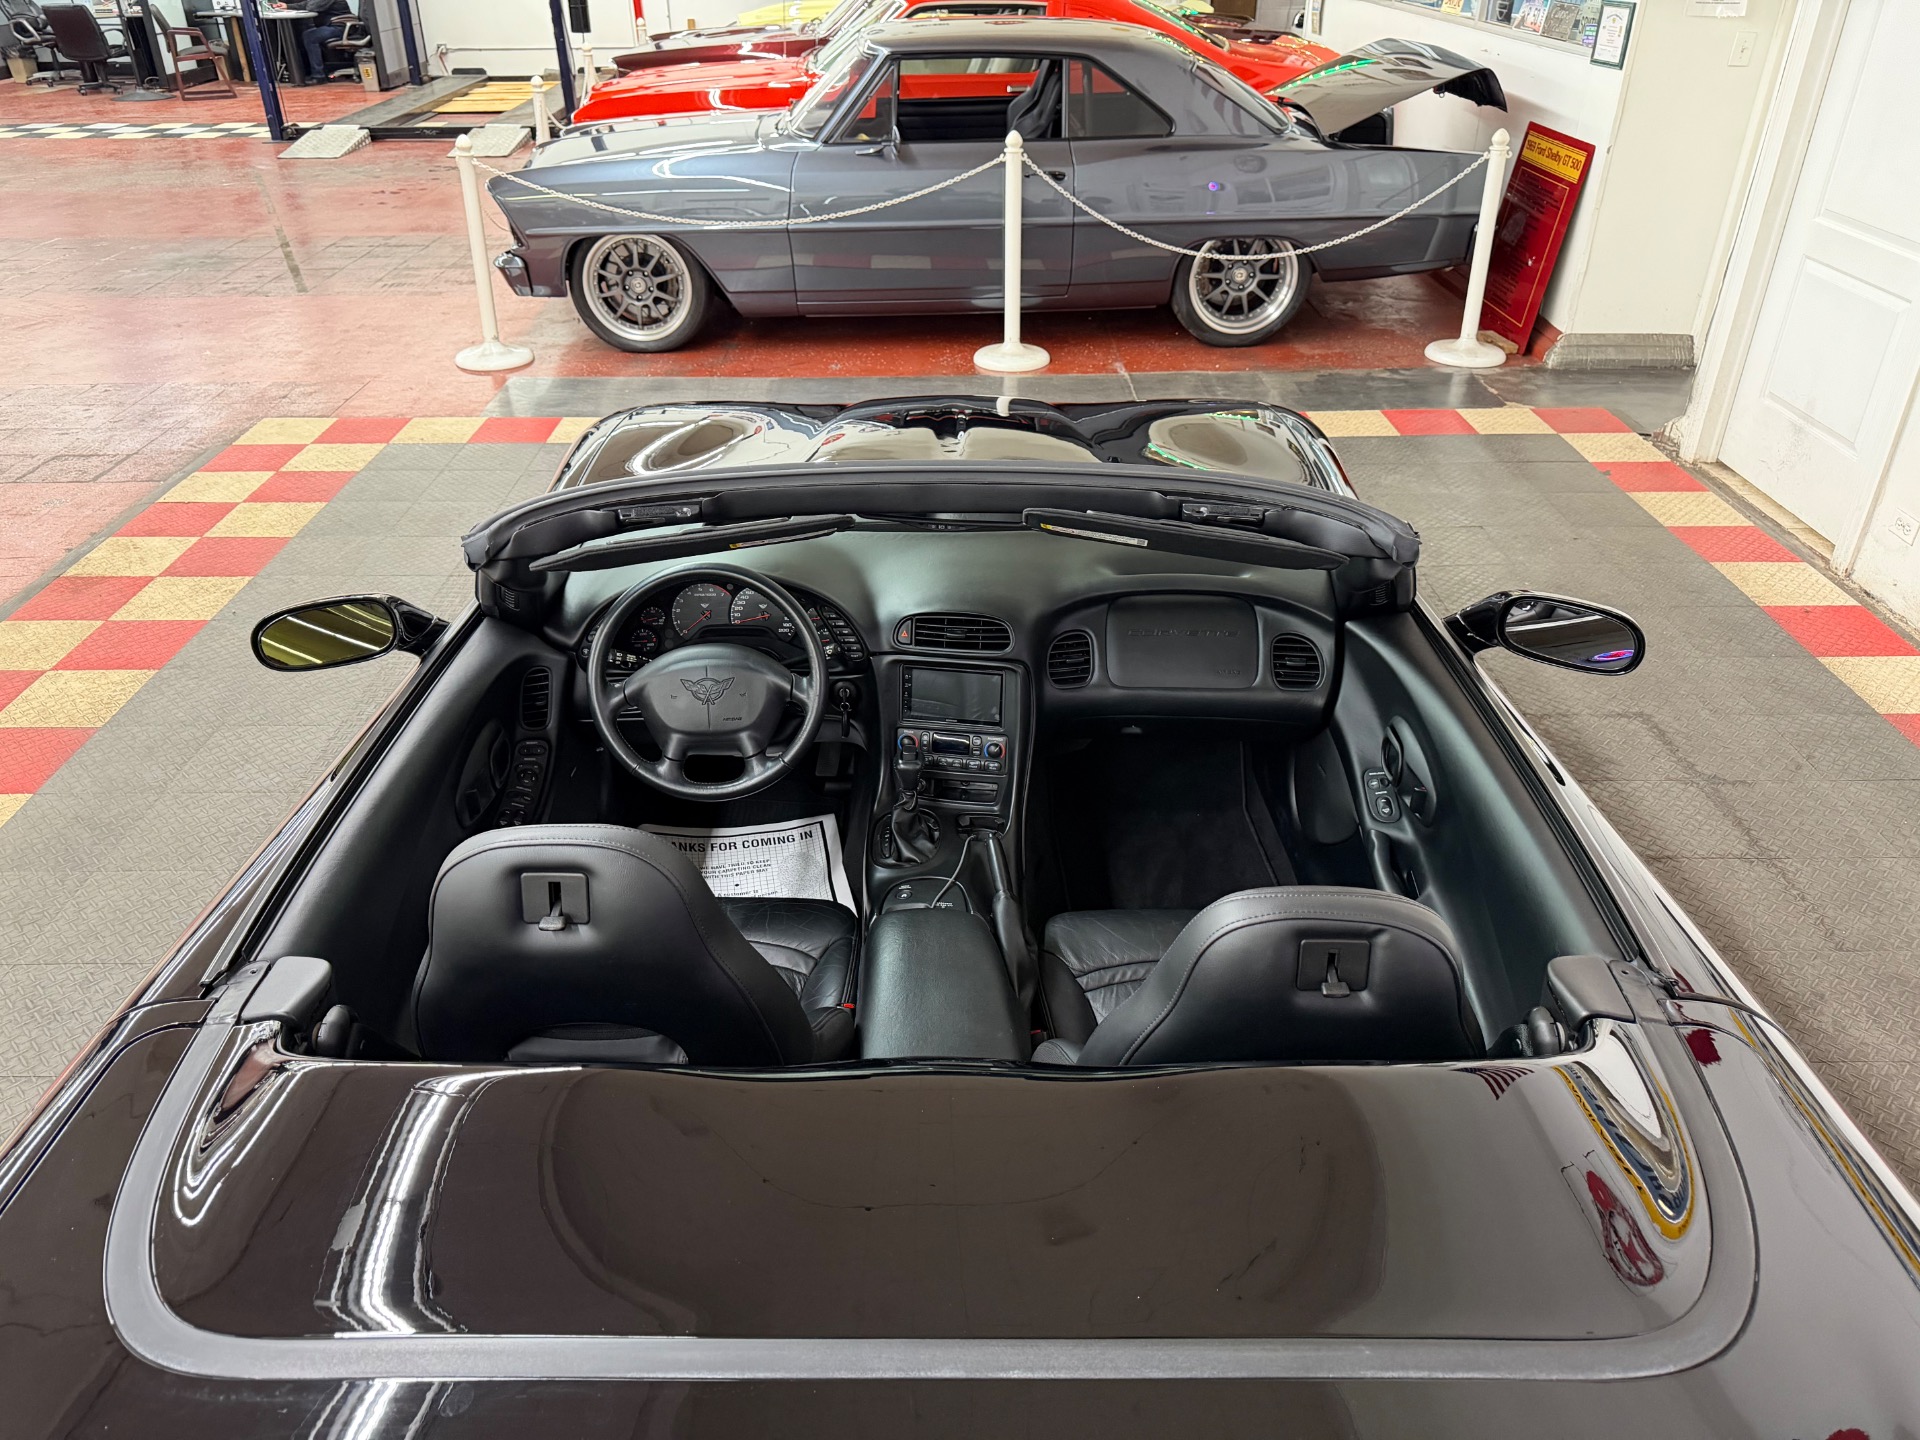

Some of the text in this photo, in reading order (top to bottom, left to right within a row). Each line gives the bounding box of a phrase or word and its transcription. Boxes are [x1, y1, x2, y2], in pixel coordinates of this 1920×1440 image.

[1535, 142, 1547, 157] Ford
[1546, 147, 1563, 166] Shelby
[1562, 154, 1571, 167] GT
[1570, 157, 1582, 172] 500
[710, 841, 737, 852] FOR
[742, 834, 795, 849] COMING
[799, 829, 813, 841] IN
[718, 866, 751, 875] CARPETING
